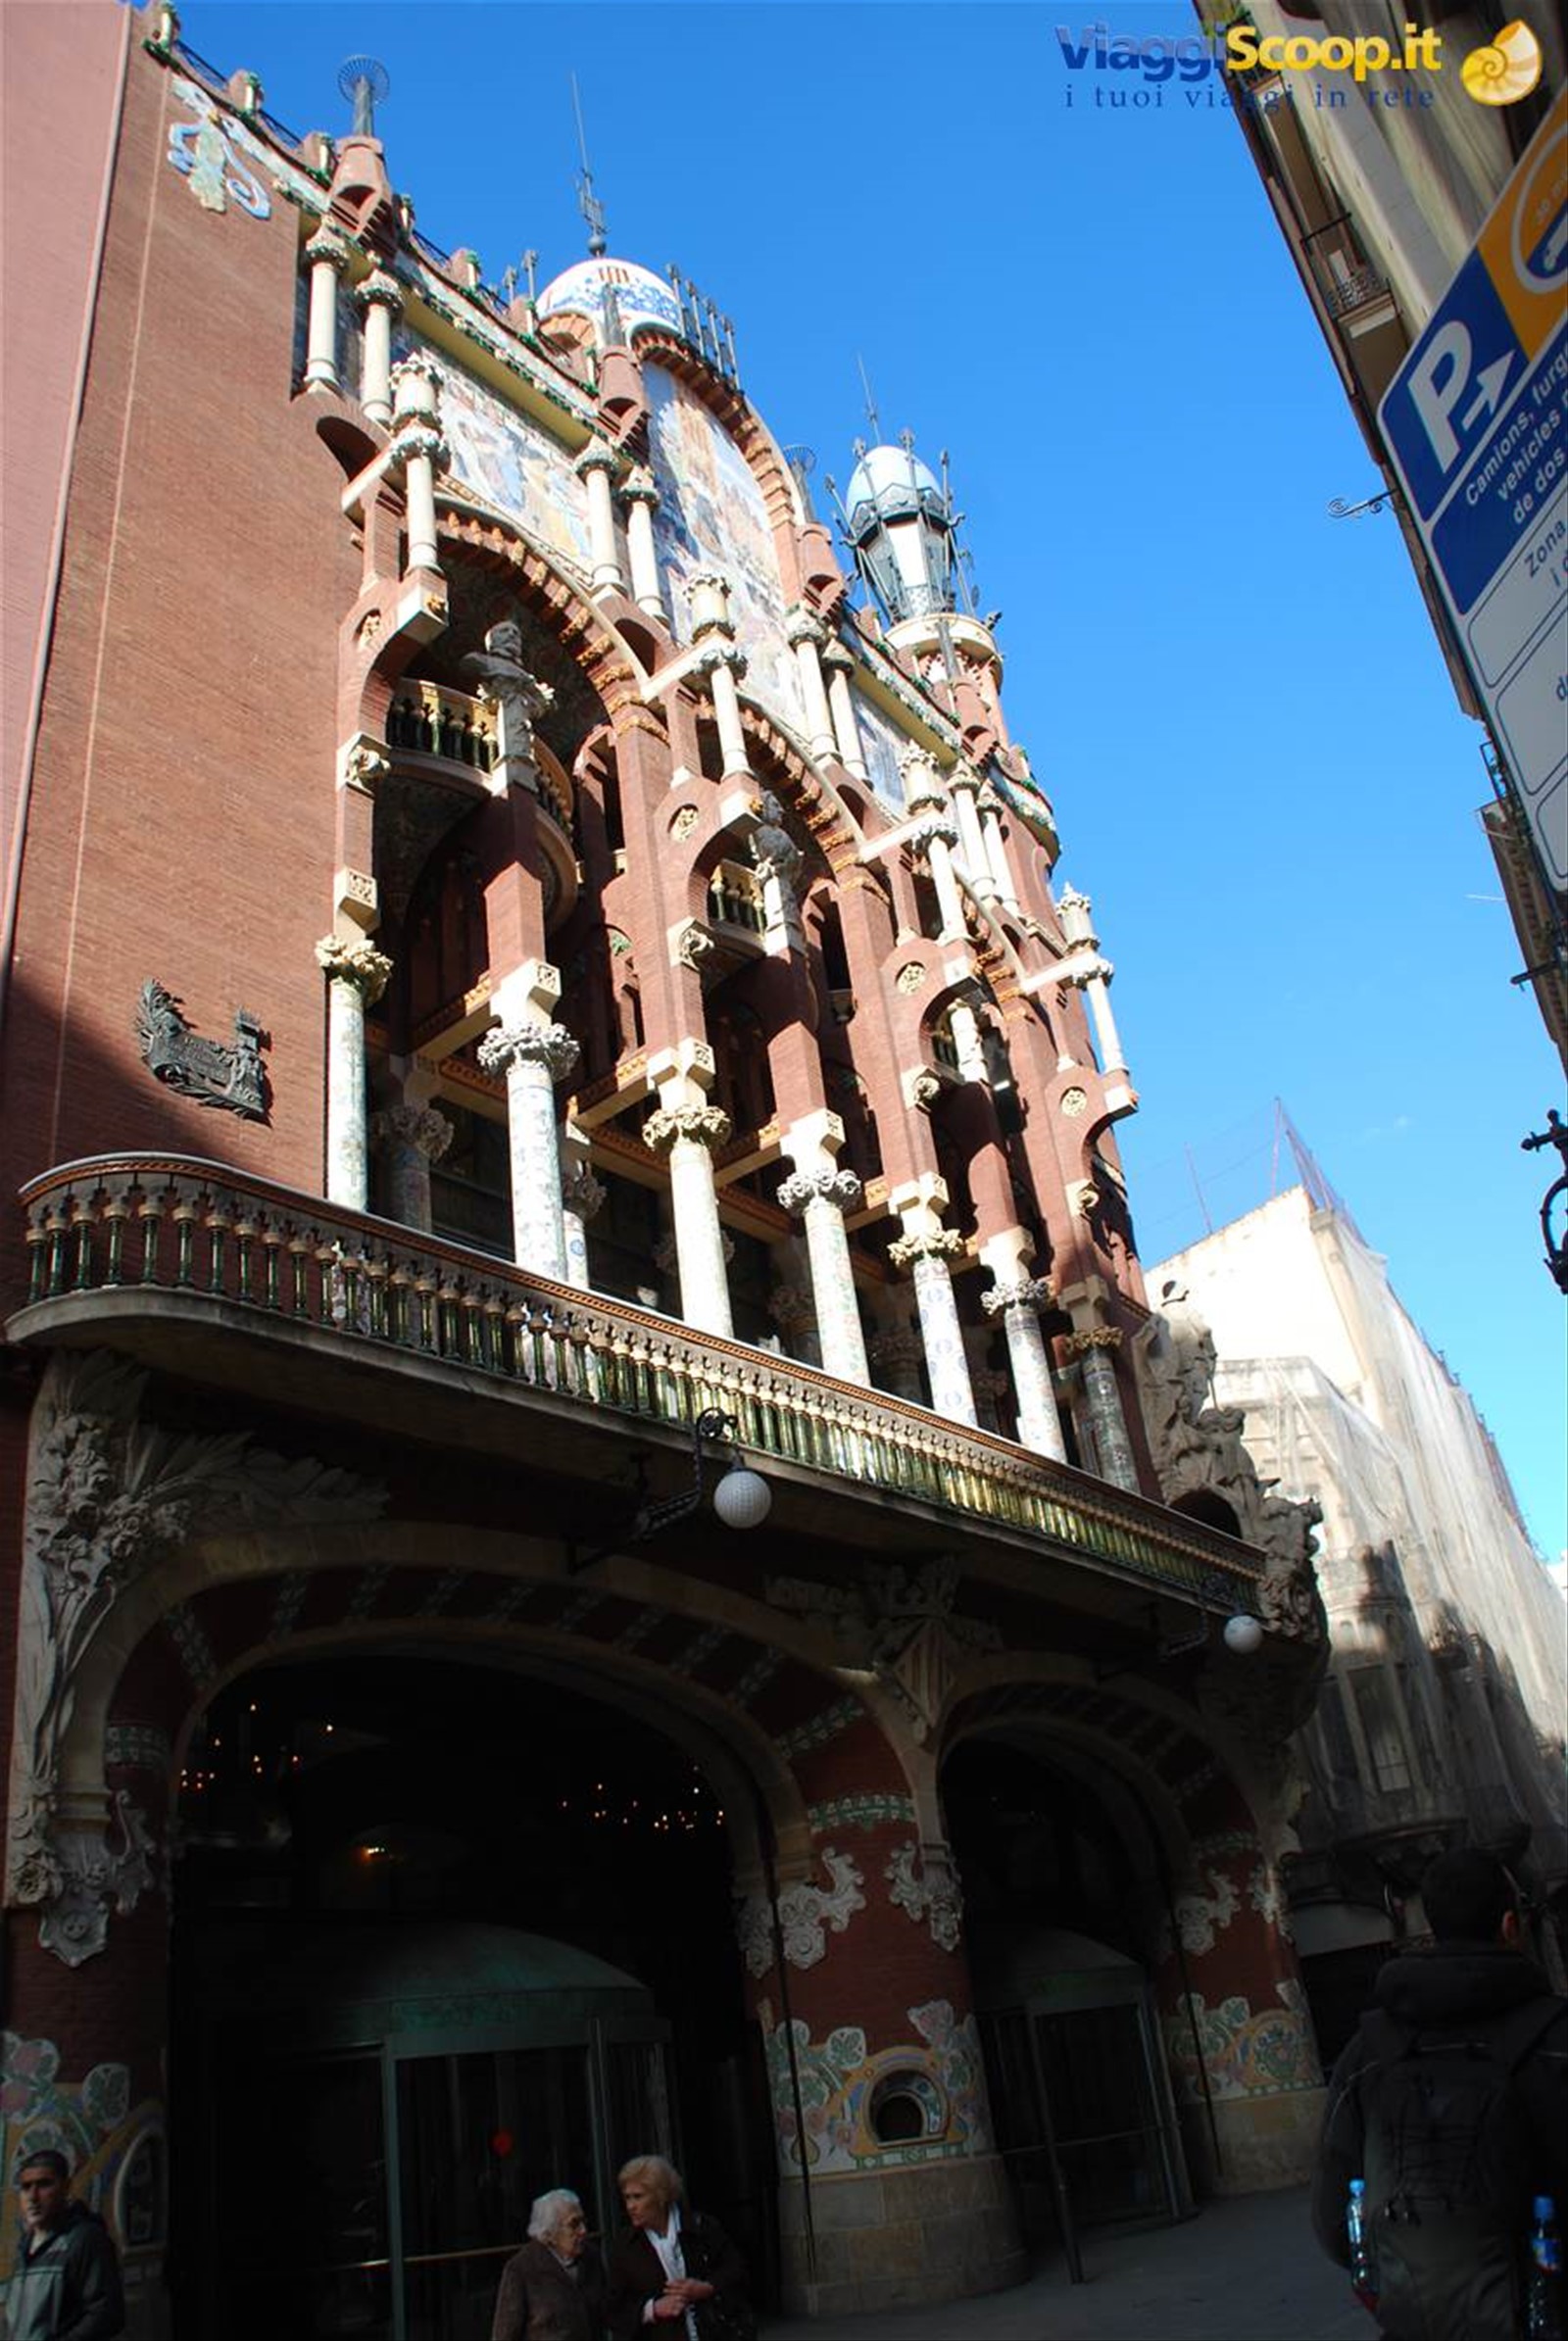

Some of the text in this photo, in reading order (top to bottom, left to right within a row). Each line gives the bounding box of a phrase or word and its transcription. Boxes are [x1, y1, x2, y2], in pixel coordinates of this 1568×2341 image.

[1408, 319, 1473, 474] P
[1466, 411, 1535, 506] Camions,
[1497, 409, 1561, 502] vehicles
[1513, 447, 1566, 523] de dos
[1524, 519, 1566, 578] Zona
